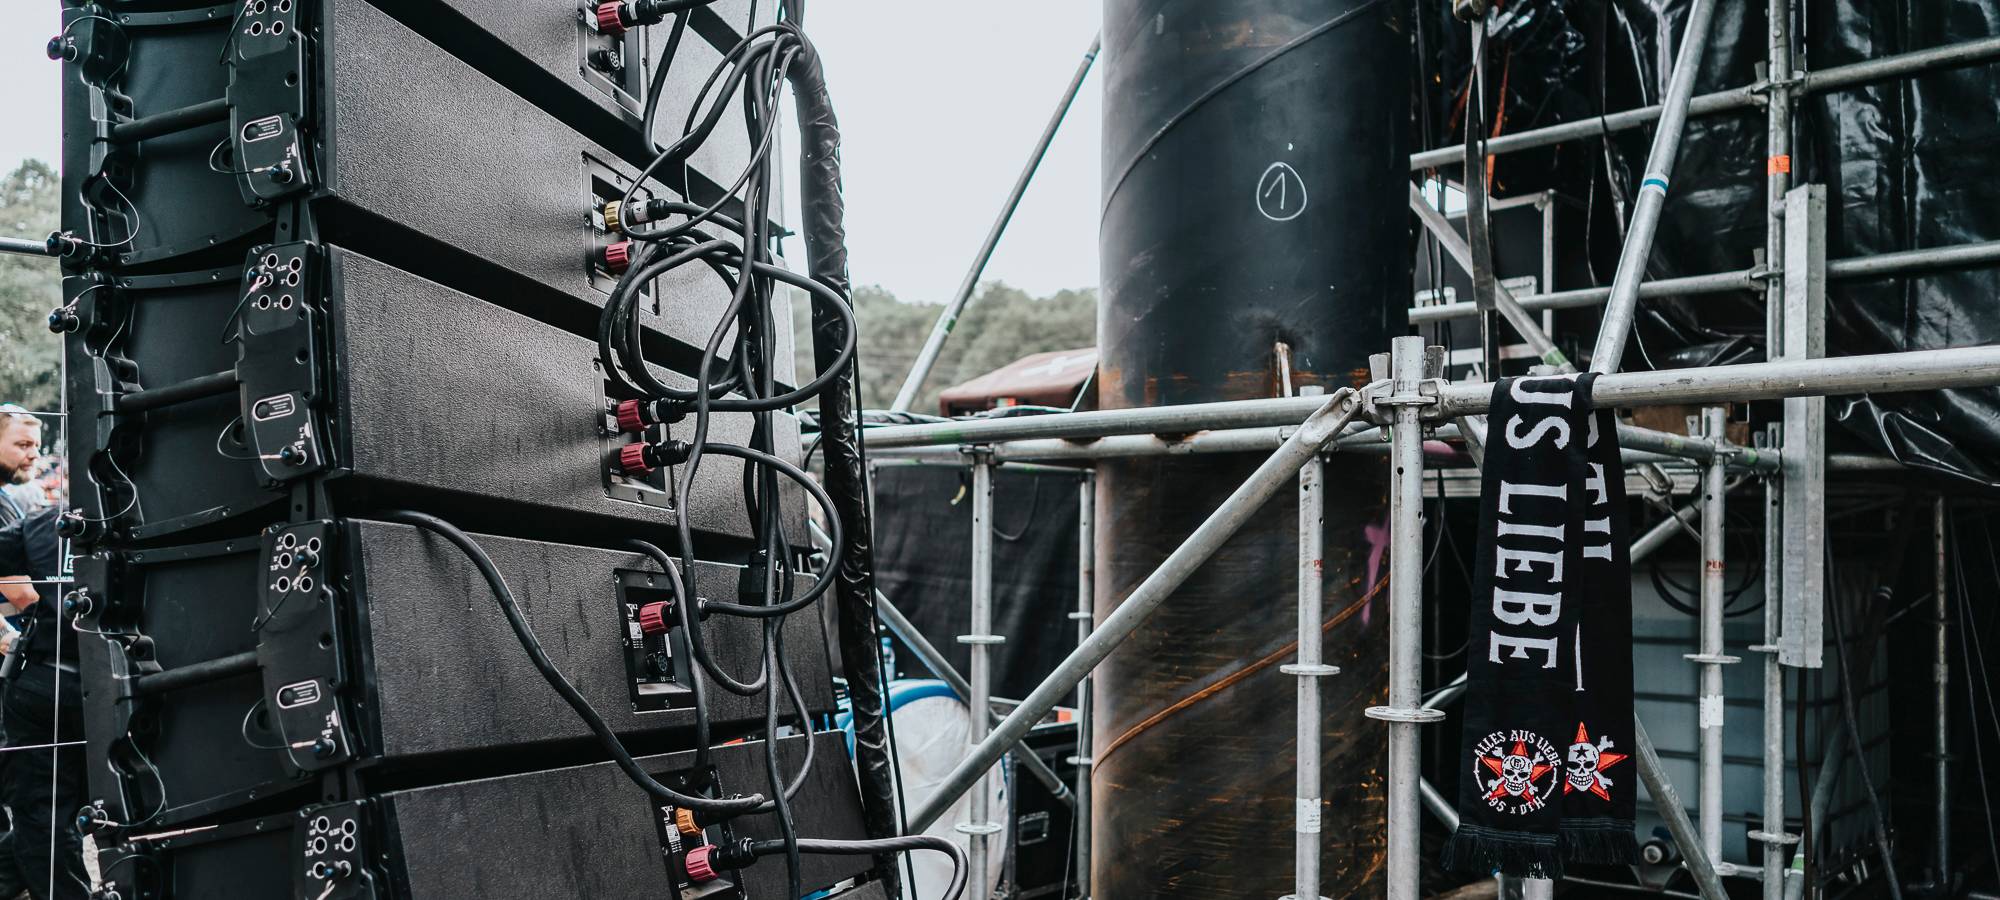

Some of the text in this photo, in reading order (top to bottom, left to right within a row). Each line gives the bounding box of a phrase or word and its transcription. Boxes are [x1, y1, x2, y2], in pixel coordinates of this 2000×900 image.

[1264, 171, 1286, 210] 1
[1489, 479, 1567, 669] LIEBE
[1474, 729, 1562, 767] ALLES AUS LIEBE
[1482, 790, 1507, 812] F95
[1520, 796, 1546, 815] DTH
